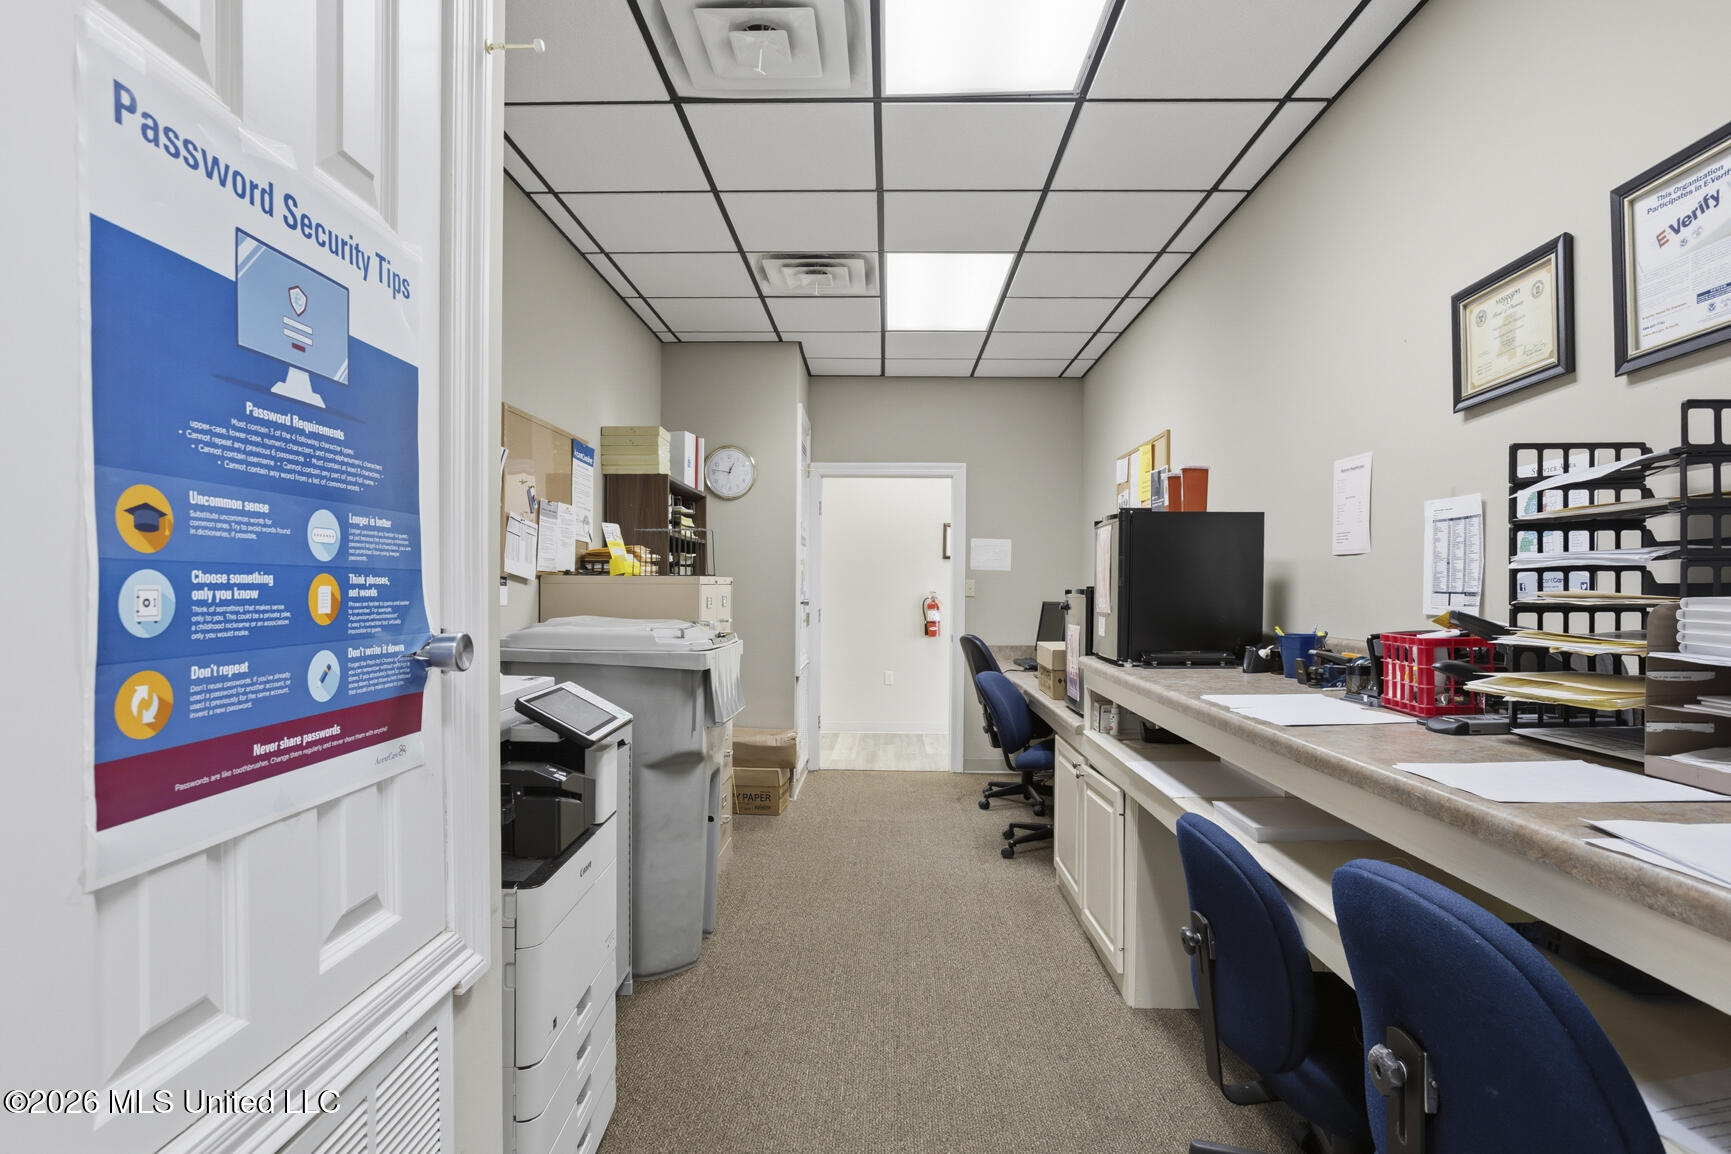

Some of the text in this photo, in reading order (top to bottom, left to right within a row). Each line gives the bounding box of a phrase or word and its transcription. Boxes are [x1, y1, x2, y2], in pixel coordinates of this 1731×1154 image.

[113, 78, 411, 300] Password Security Tips
[1657, 164, 1724, 202] This Organization
[1646, 168, 1731, 215] Participates in E-Verif
[246, 401, 344, 440] Password Requirements
[231, 418, 246, 428] Must
[247, 424, 269, 434] contain
[275, 428, 280, 436] of
[282, 430, 291, 440] the
[296, 434, 320, 448] following
[186, 430, 211, 442] Cannot
[212, 437, 232, 447] repeat
[234, 442, 245, 451] any
[246, 445, 270, 455] previous
[276, 451, 304, 462] passwords
[264, 438, 286, 448] numeric
[198, 444, 222, 456] Cannot
[224, 450, 246, 460] contain
[247, 455, 275, 466] username
[282, 461, 302, 472] Cannot
[302, 466, 322, 476] contain
[224, 460, 246, 472] Cannot
[248, 466, 269, 476] contain
[281, 472, 294, 480] word
[189, 490, 270, 513] Uncommon sense
[190, 510, 218, 520] Substitute
[220, 514, 248, 523] uncommon
[249, 516, 264, 525] words
[348, 513, 392, 528] Longer is better
[190, 520, 216, 528] common
[231, 522, 240, 532] Try
[192, 570, 274, 586] Choose something
[348, 574, 390, 586] Think phrases,
[192, 586, 259, 603] only you know
[348, 586, 378, 598] not words
[216, 604, 244, 612] something
[191, 614, 204, 622] only
[196, 621, 225, 631] childhood
[226, 620, 250, 628] nickname
[191, 631, 204, 640] only
[205, 631, 216, 640] you
[218, 630, 234, 638] would
[348, 643, 404, 658] Don't write it down
[190, 661, 249, 680] Don't repeat
[274, 672, 292, 680] already
[190, 693, 206, 702] used
[210, 687, 237, 698] password
[238, 686, 246, 694] for
[246, 684, 266, 692] another
[190, 702, 206, 711] used
[210, 696, 239, 707] previously
[190, 710, 208, 720] invent
[214, 706, 226, 714] new
[253, 741, 278, 757] Never
[280, 735, 302, 750] share
[303, 724, 341, 746] passwords
[174, 776, 210, 792] Passwords
[210, 772, 220, 782] are
[222, 769, 232, 778] like
[270, 754, 290, 764] Change
[290, 750, 302, 759] them
[742, 792, 772, 802] PAPER
